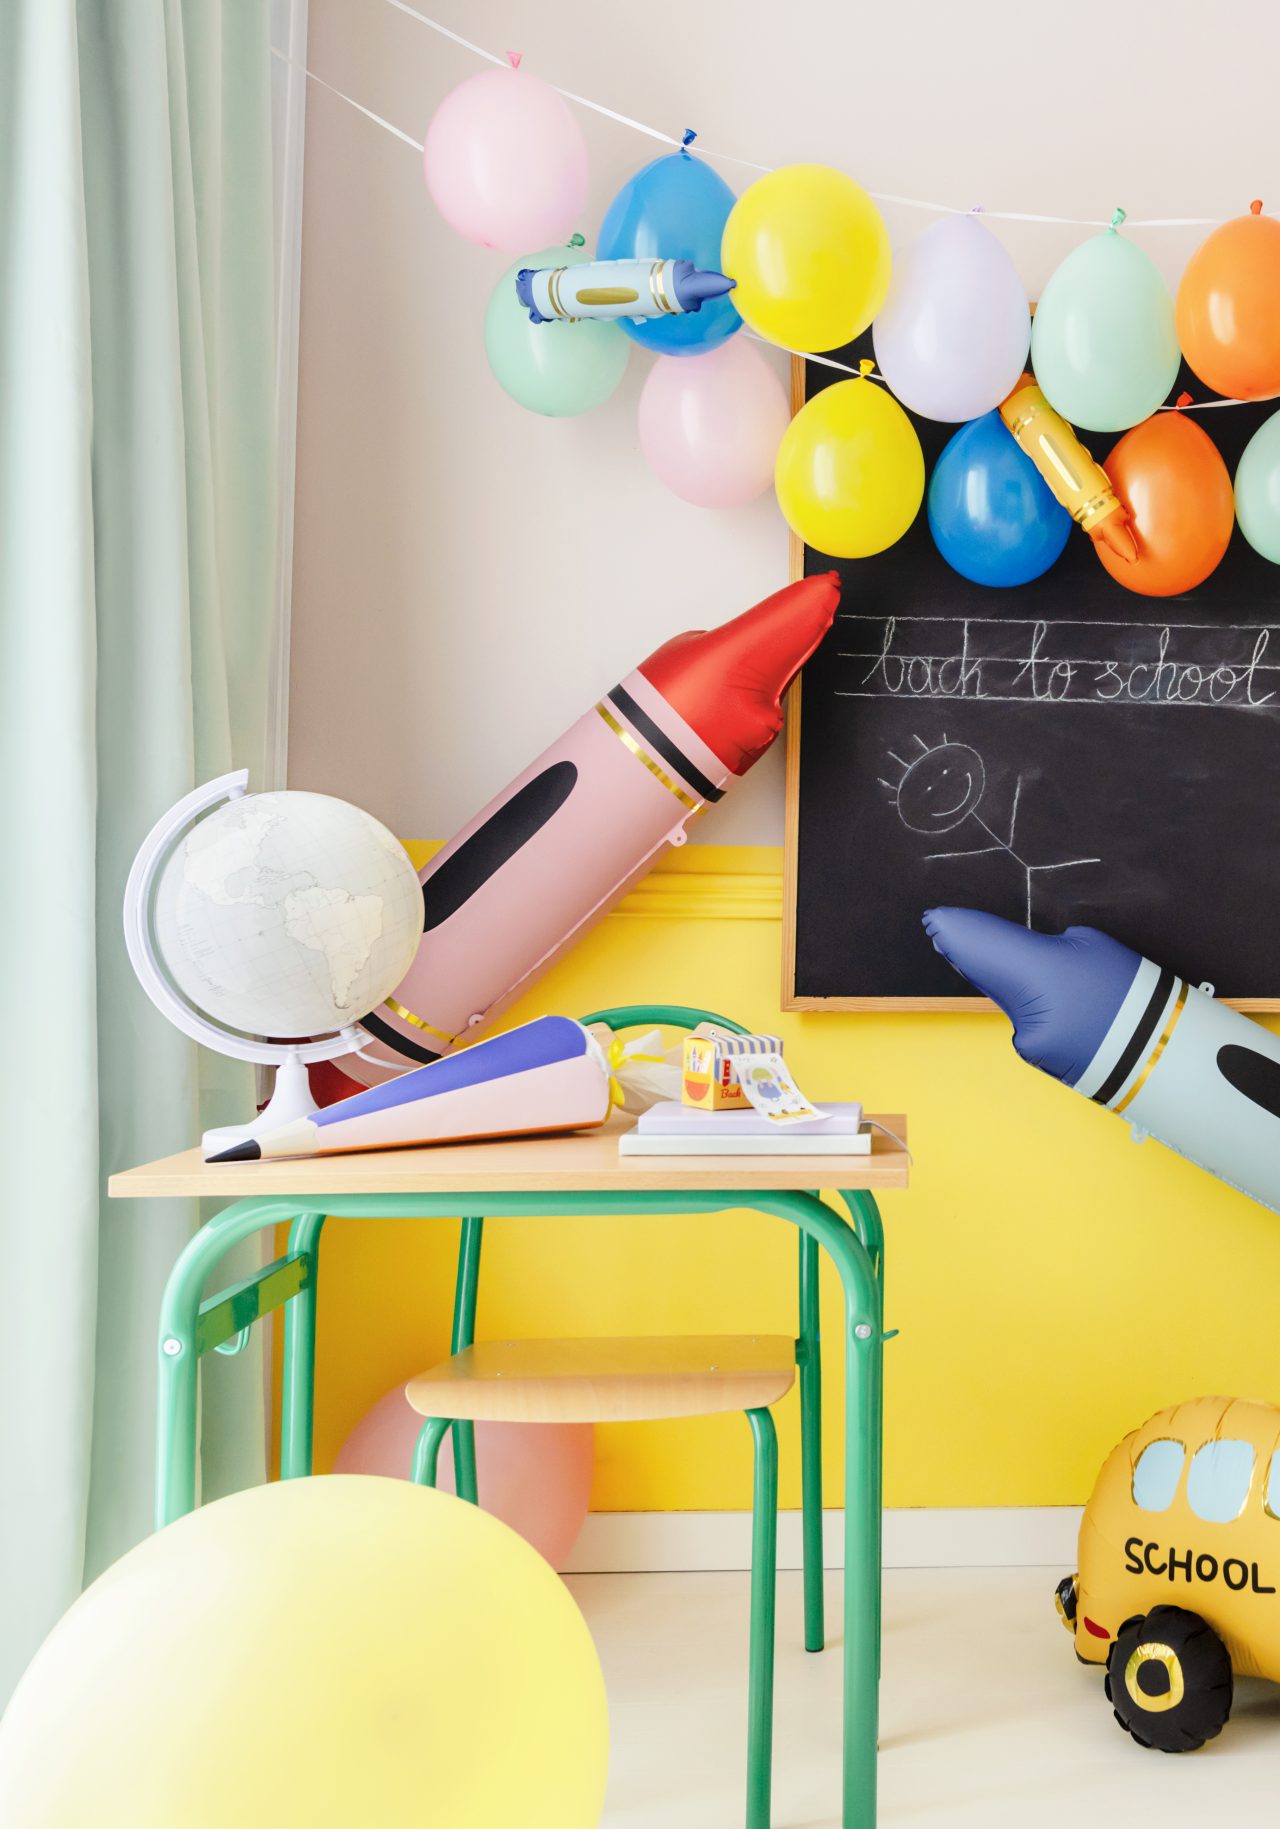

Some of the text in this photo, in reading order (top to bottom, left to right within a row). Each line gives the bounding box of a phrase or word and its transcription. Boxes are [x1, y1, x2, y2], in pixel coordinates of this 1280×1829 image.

[861, 616, 1277, 705] back to school
[1124, 1537, 1276, 1594] SCHOOL
